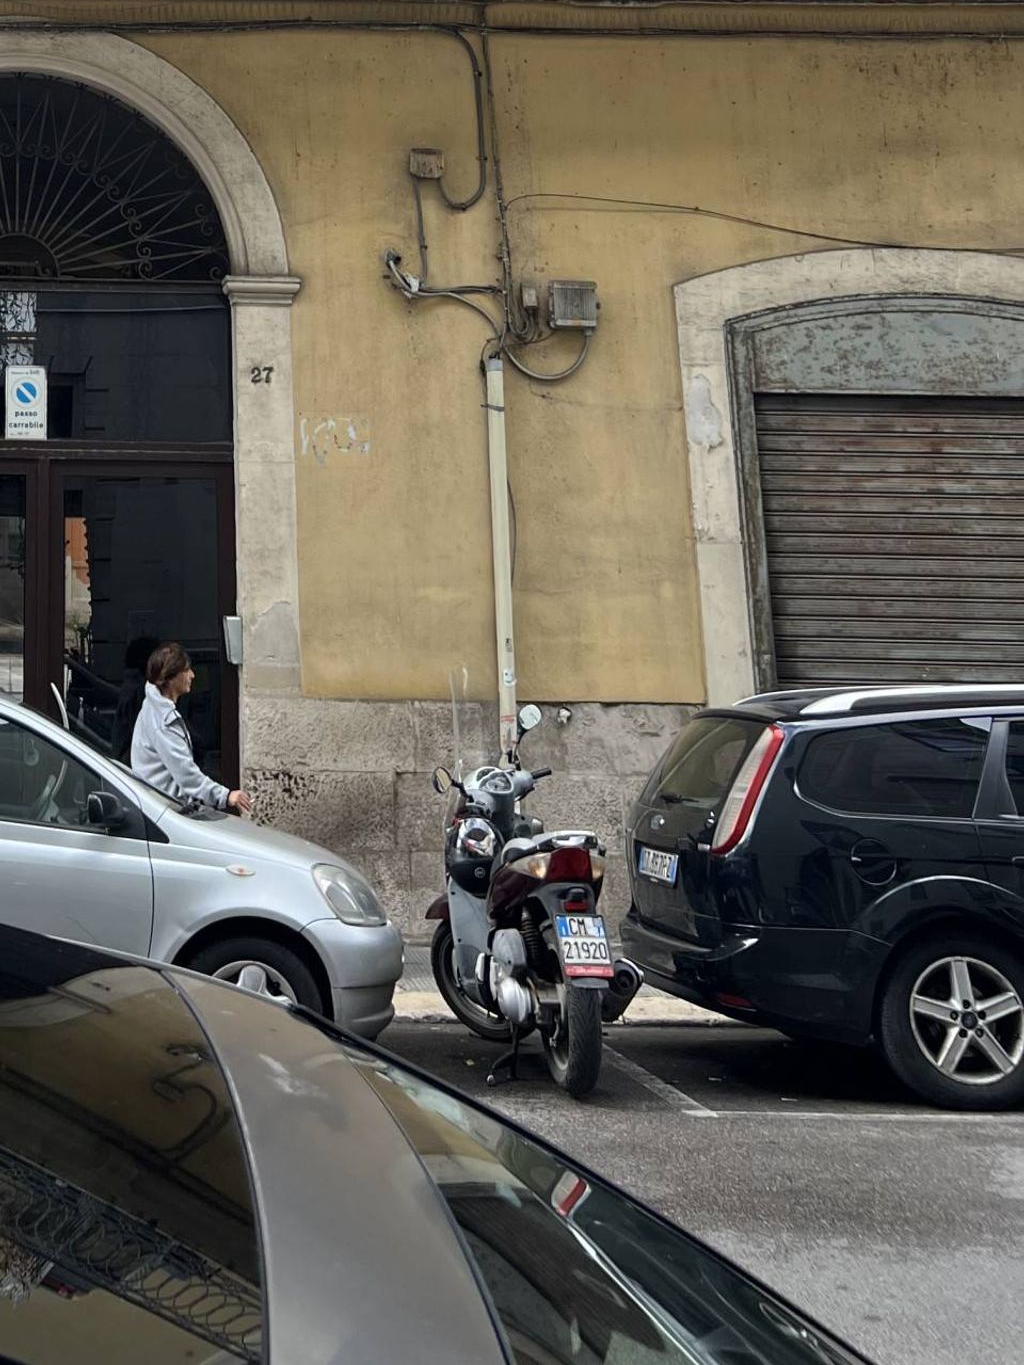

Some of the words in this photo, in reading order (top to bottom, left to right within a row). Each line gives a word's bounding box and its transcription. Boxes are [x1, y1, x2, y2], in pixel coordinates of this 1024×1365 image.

[250, 366, 274, 384] 27
[14, 410, 38, 418] passo
[8, 421, 44, 429] carrabile
[568, 918, 587, 935] CM
[563, 941, 607, 960] 21920
